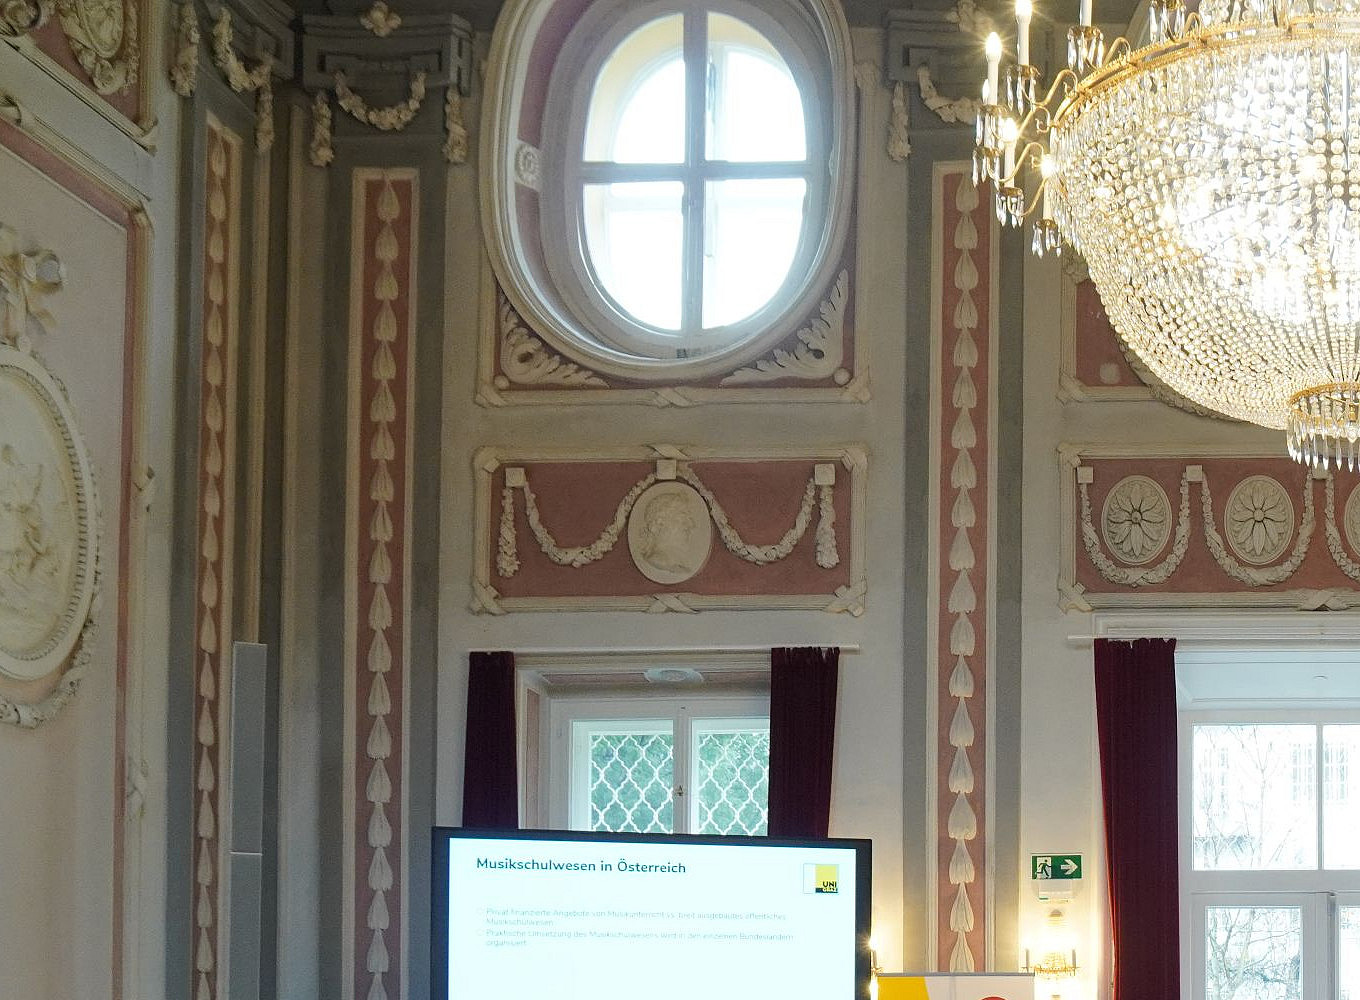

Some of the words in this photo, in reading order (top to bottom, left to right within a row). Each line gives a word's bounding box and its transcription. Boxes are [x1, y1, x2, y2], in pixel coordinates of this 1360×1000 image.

[476, 858, 596, 872] Musikschulwesen
[600, 861, 613, 871] in
[617, 858, 686, 873] Österreich
